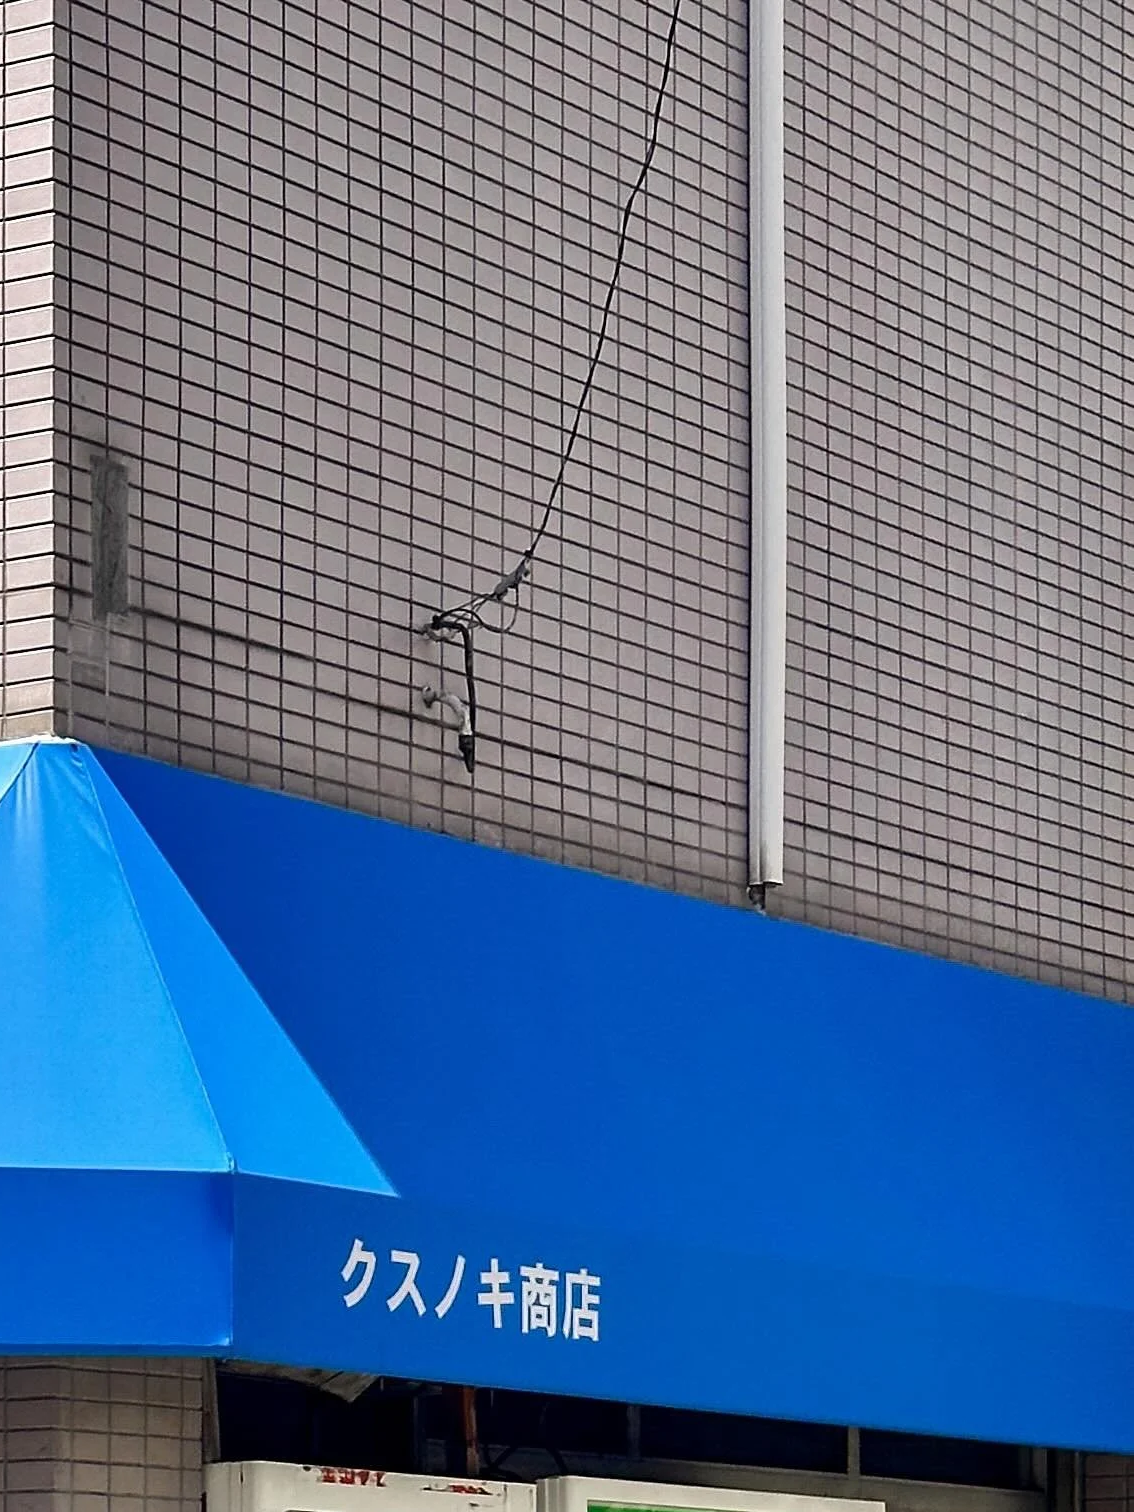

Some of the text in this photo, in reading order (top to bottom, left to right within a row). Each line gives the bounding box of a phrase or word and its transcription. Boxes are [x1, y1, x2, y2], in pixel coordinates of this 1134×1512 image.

[340, 1237, 601, 1341] クスノキ商店
